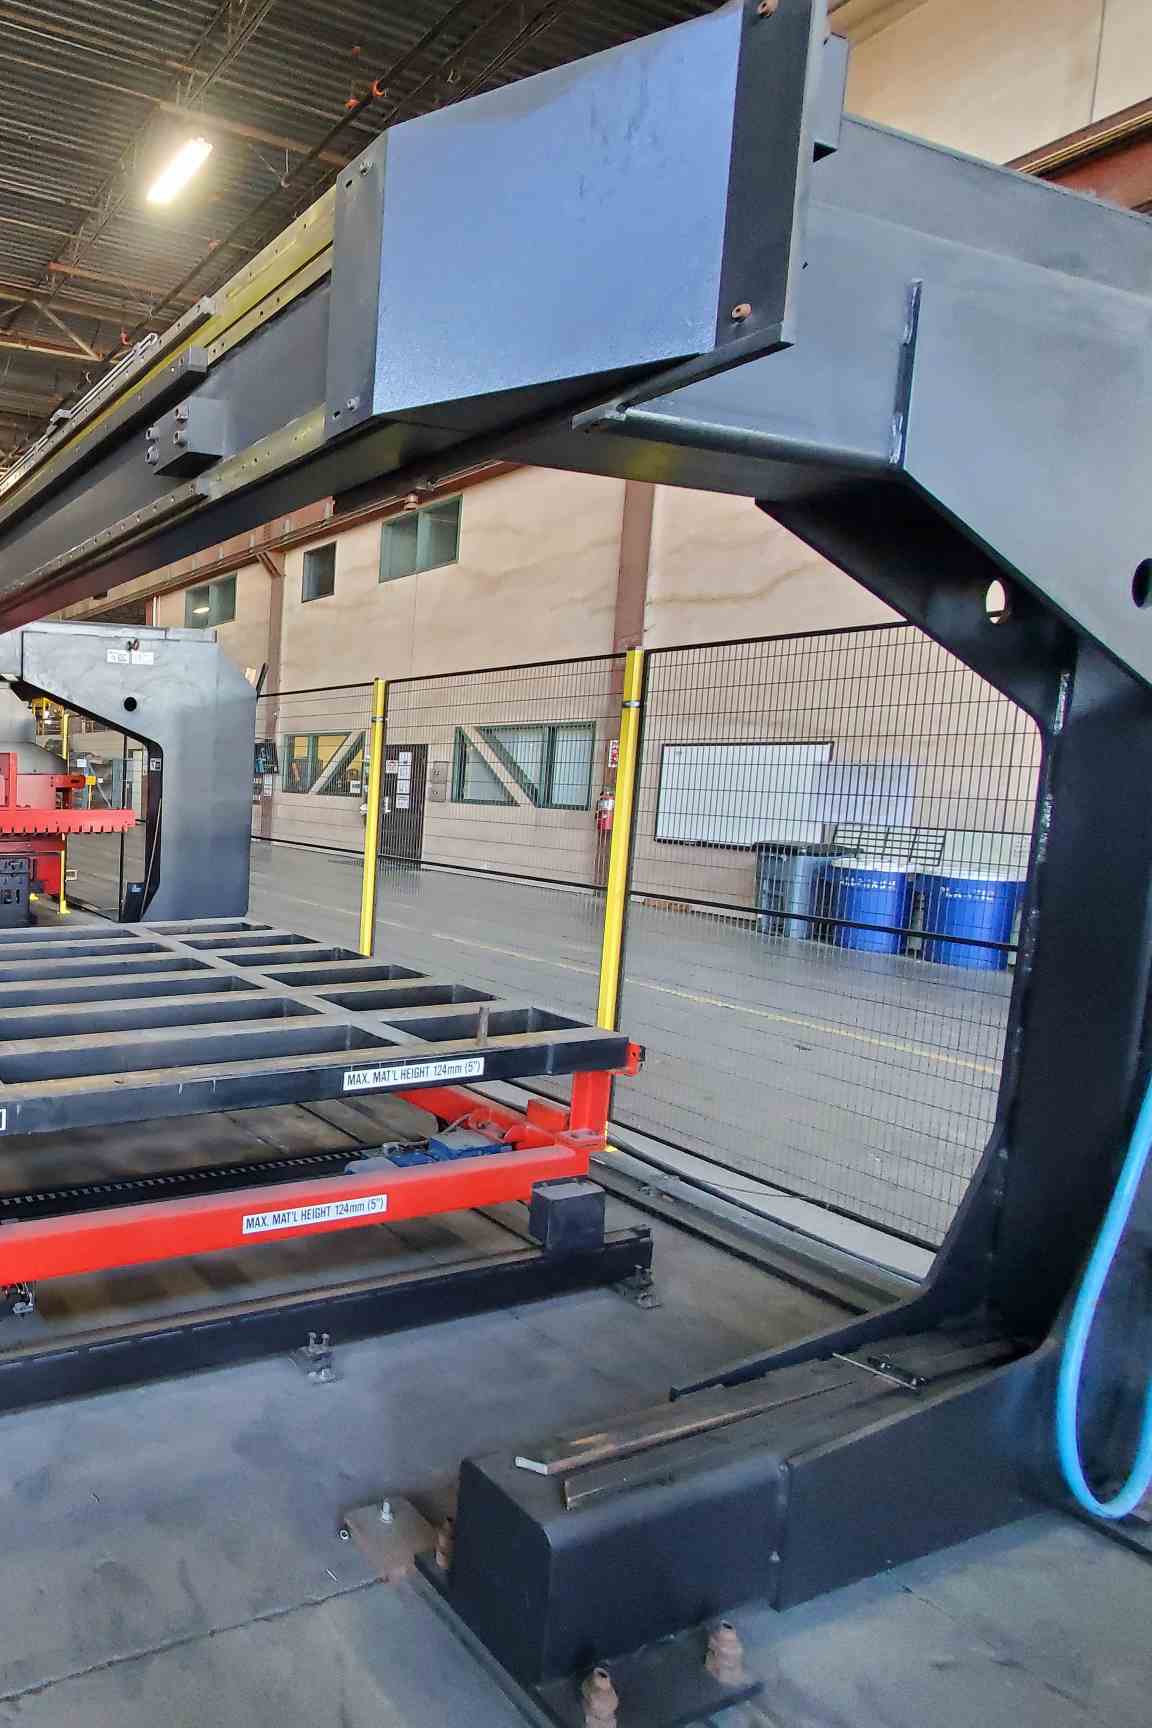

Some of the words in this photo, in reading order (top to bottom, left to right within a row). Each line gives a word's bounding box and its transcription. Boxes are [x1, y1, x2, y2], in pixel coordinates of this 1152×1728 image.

[347, 1073, 371, 1086] MAX.
[373, 1069, 398, 1083] MAT'L
[400, 1066, 430, 1080] HEIGHT
[434, 1063, 462, 1076] 124mm
[245, 1215, 269, 1230] MAX.
[272, 1211, 298, 1225] MAT'L
[301, 1206, 331, 1220] HEIGHT
[336, 1201, 365, 1216] 124mm
